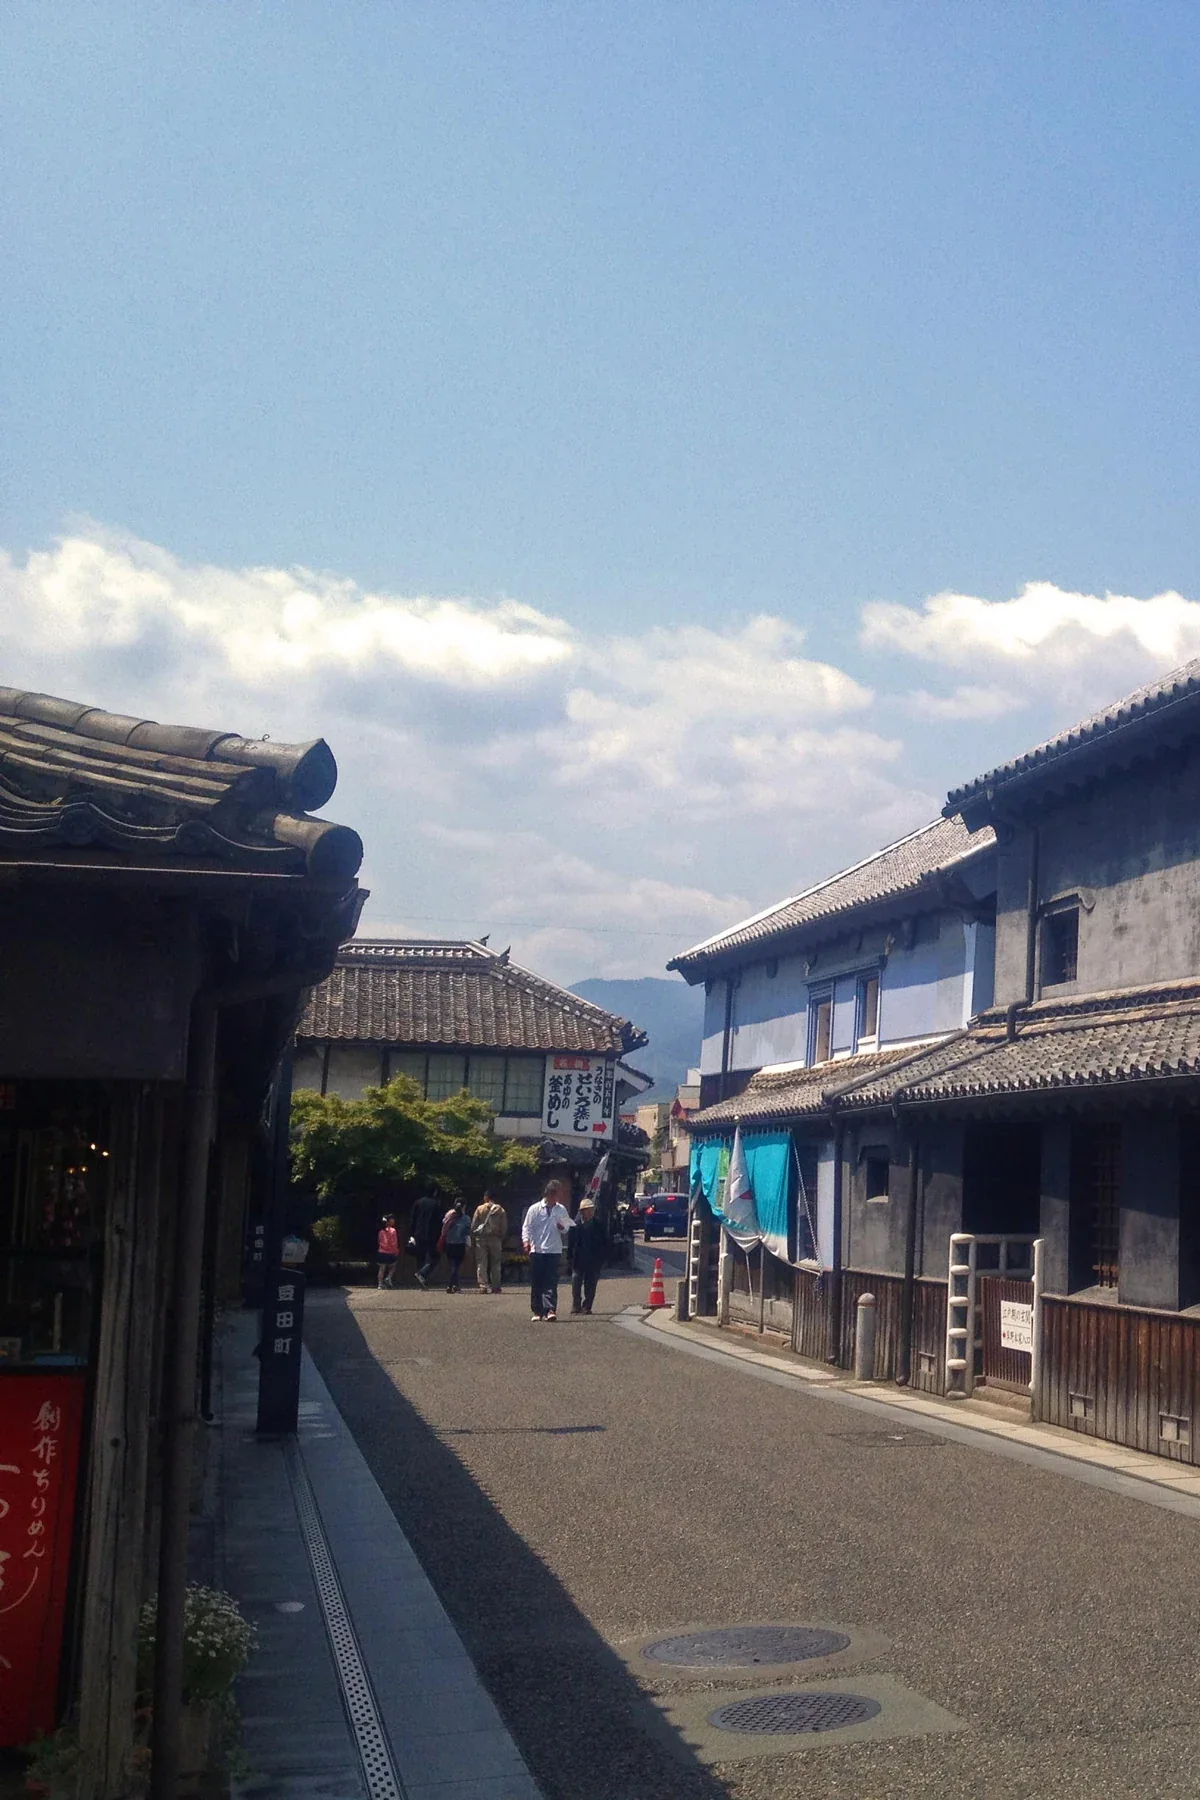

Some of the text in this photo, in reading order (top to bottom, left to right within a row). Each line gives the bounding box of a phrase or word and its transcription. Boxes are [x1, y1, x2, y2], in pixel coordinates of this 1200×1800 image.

[547, 1075, 563, 1129] 釜めし
[561, 1073, 573, 1110] あゆの
[573, 1072, 593, 1132] せいろ蒸し
[274, 1284, 296, 1354] 豆田町
[23, 1400, 61, 1560] 創作ちりめん
